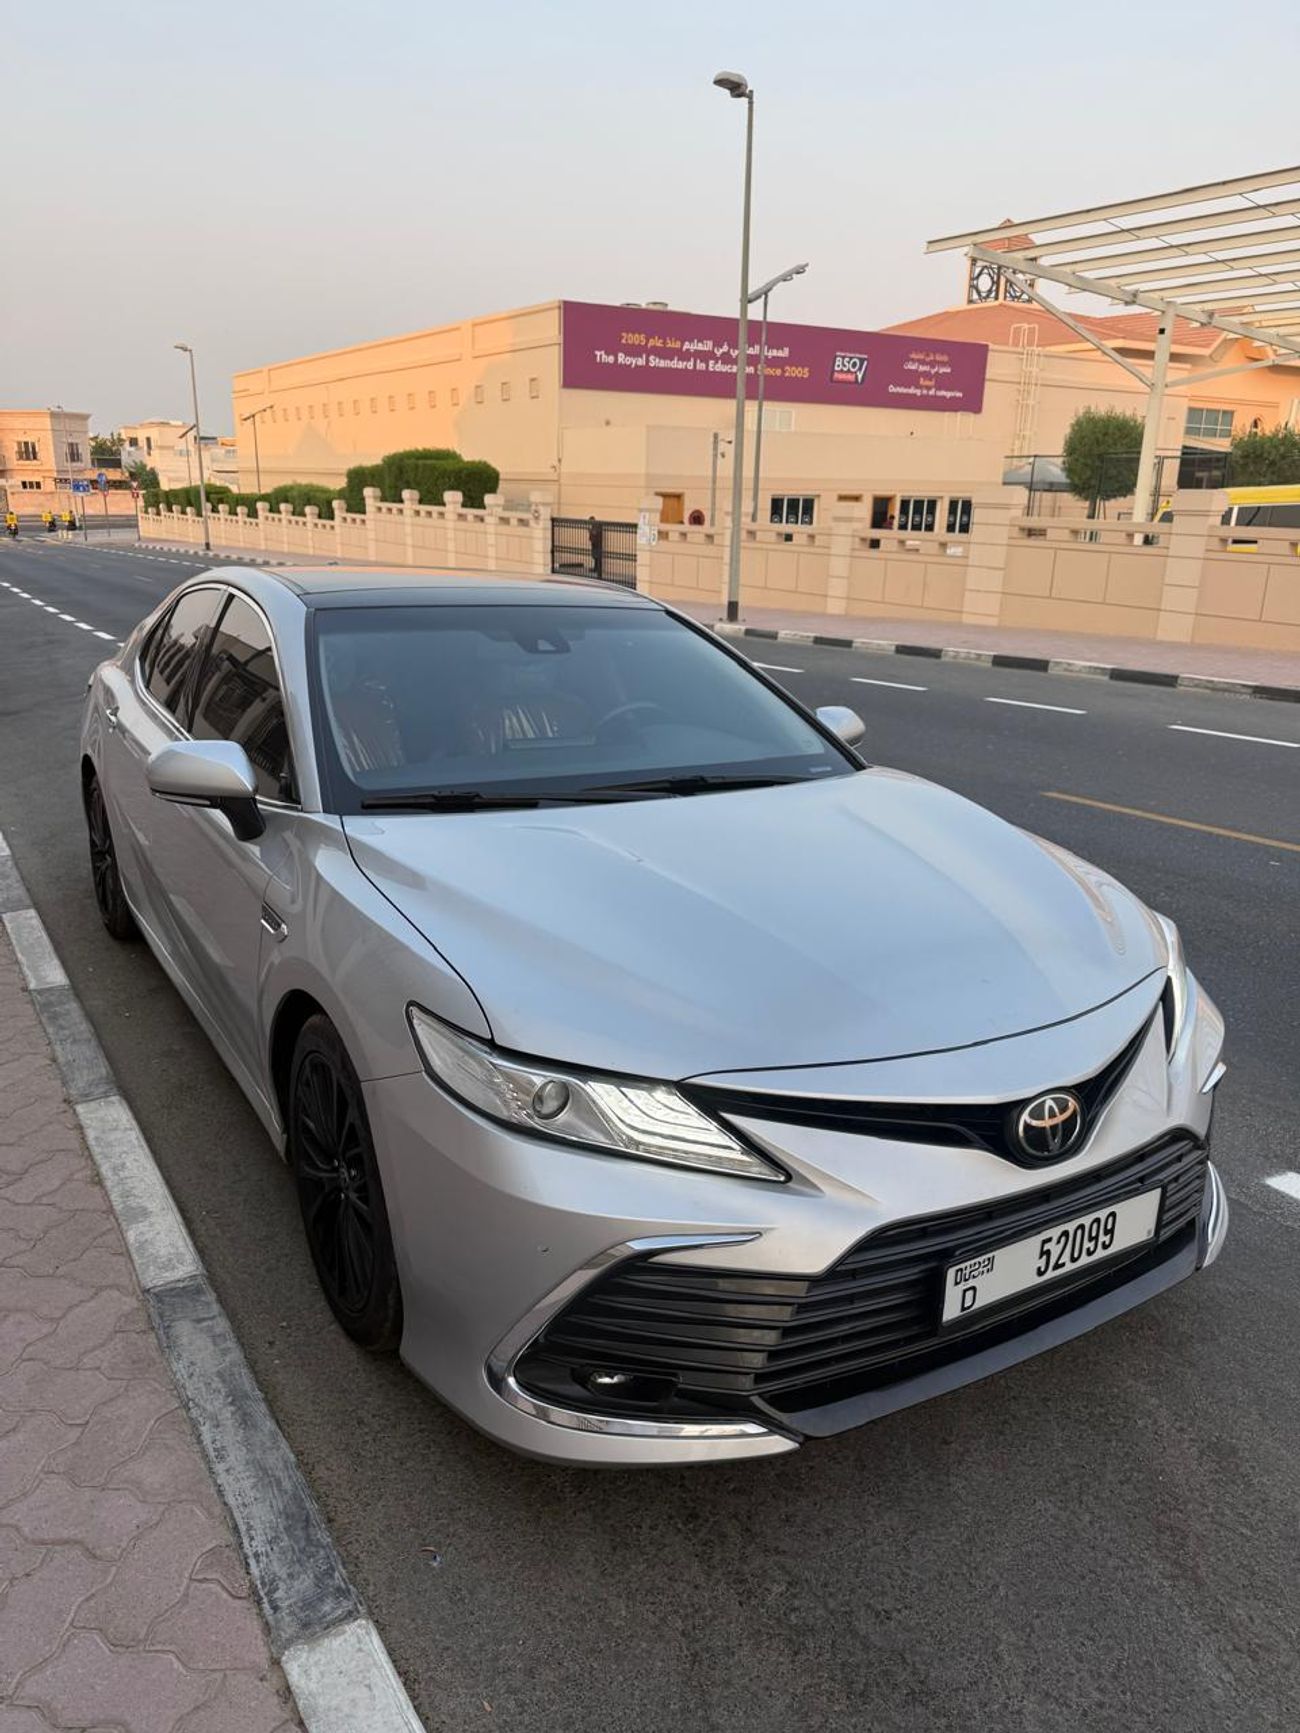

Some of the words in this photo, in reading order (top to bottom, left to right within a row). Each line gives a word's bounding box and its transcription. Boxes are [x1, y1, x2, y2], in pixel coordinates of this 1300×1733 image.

[621, 332, 646, 346] 2005
[682, 338, 713, 352] التعليم
[714, 341, 729, 357] في
[595, 350, 615, 364] The
[617, 352, 646, 368] Royal
[648, 354, 694, 370] Standard
[783, 366, 810, 378] 2005
[834, 356, 860, 373] BSO
[888, 384, 921, 397] Outstanding
[1036, 1210, 1117, 1278] 52099
[960, 1285, 978, 1313] D
